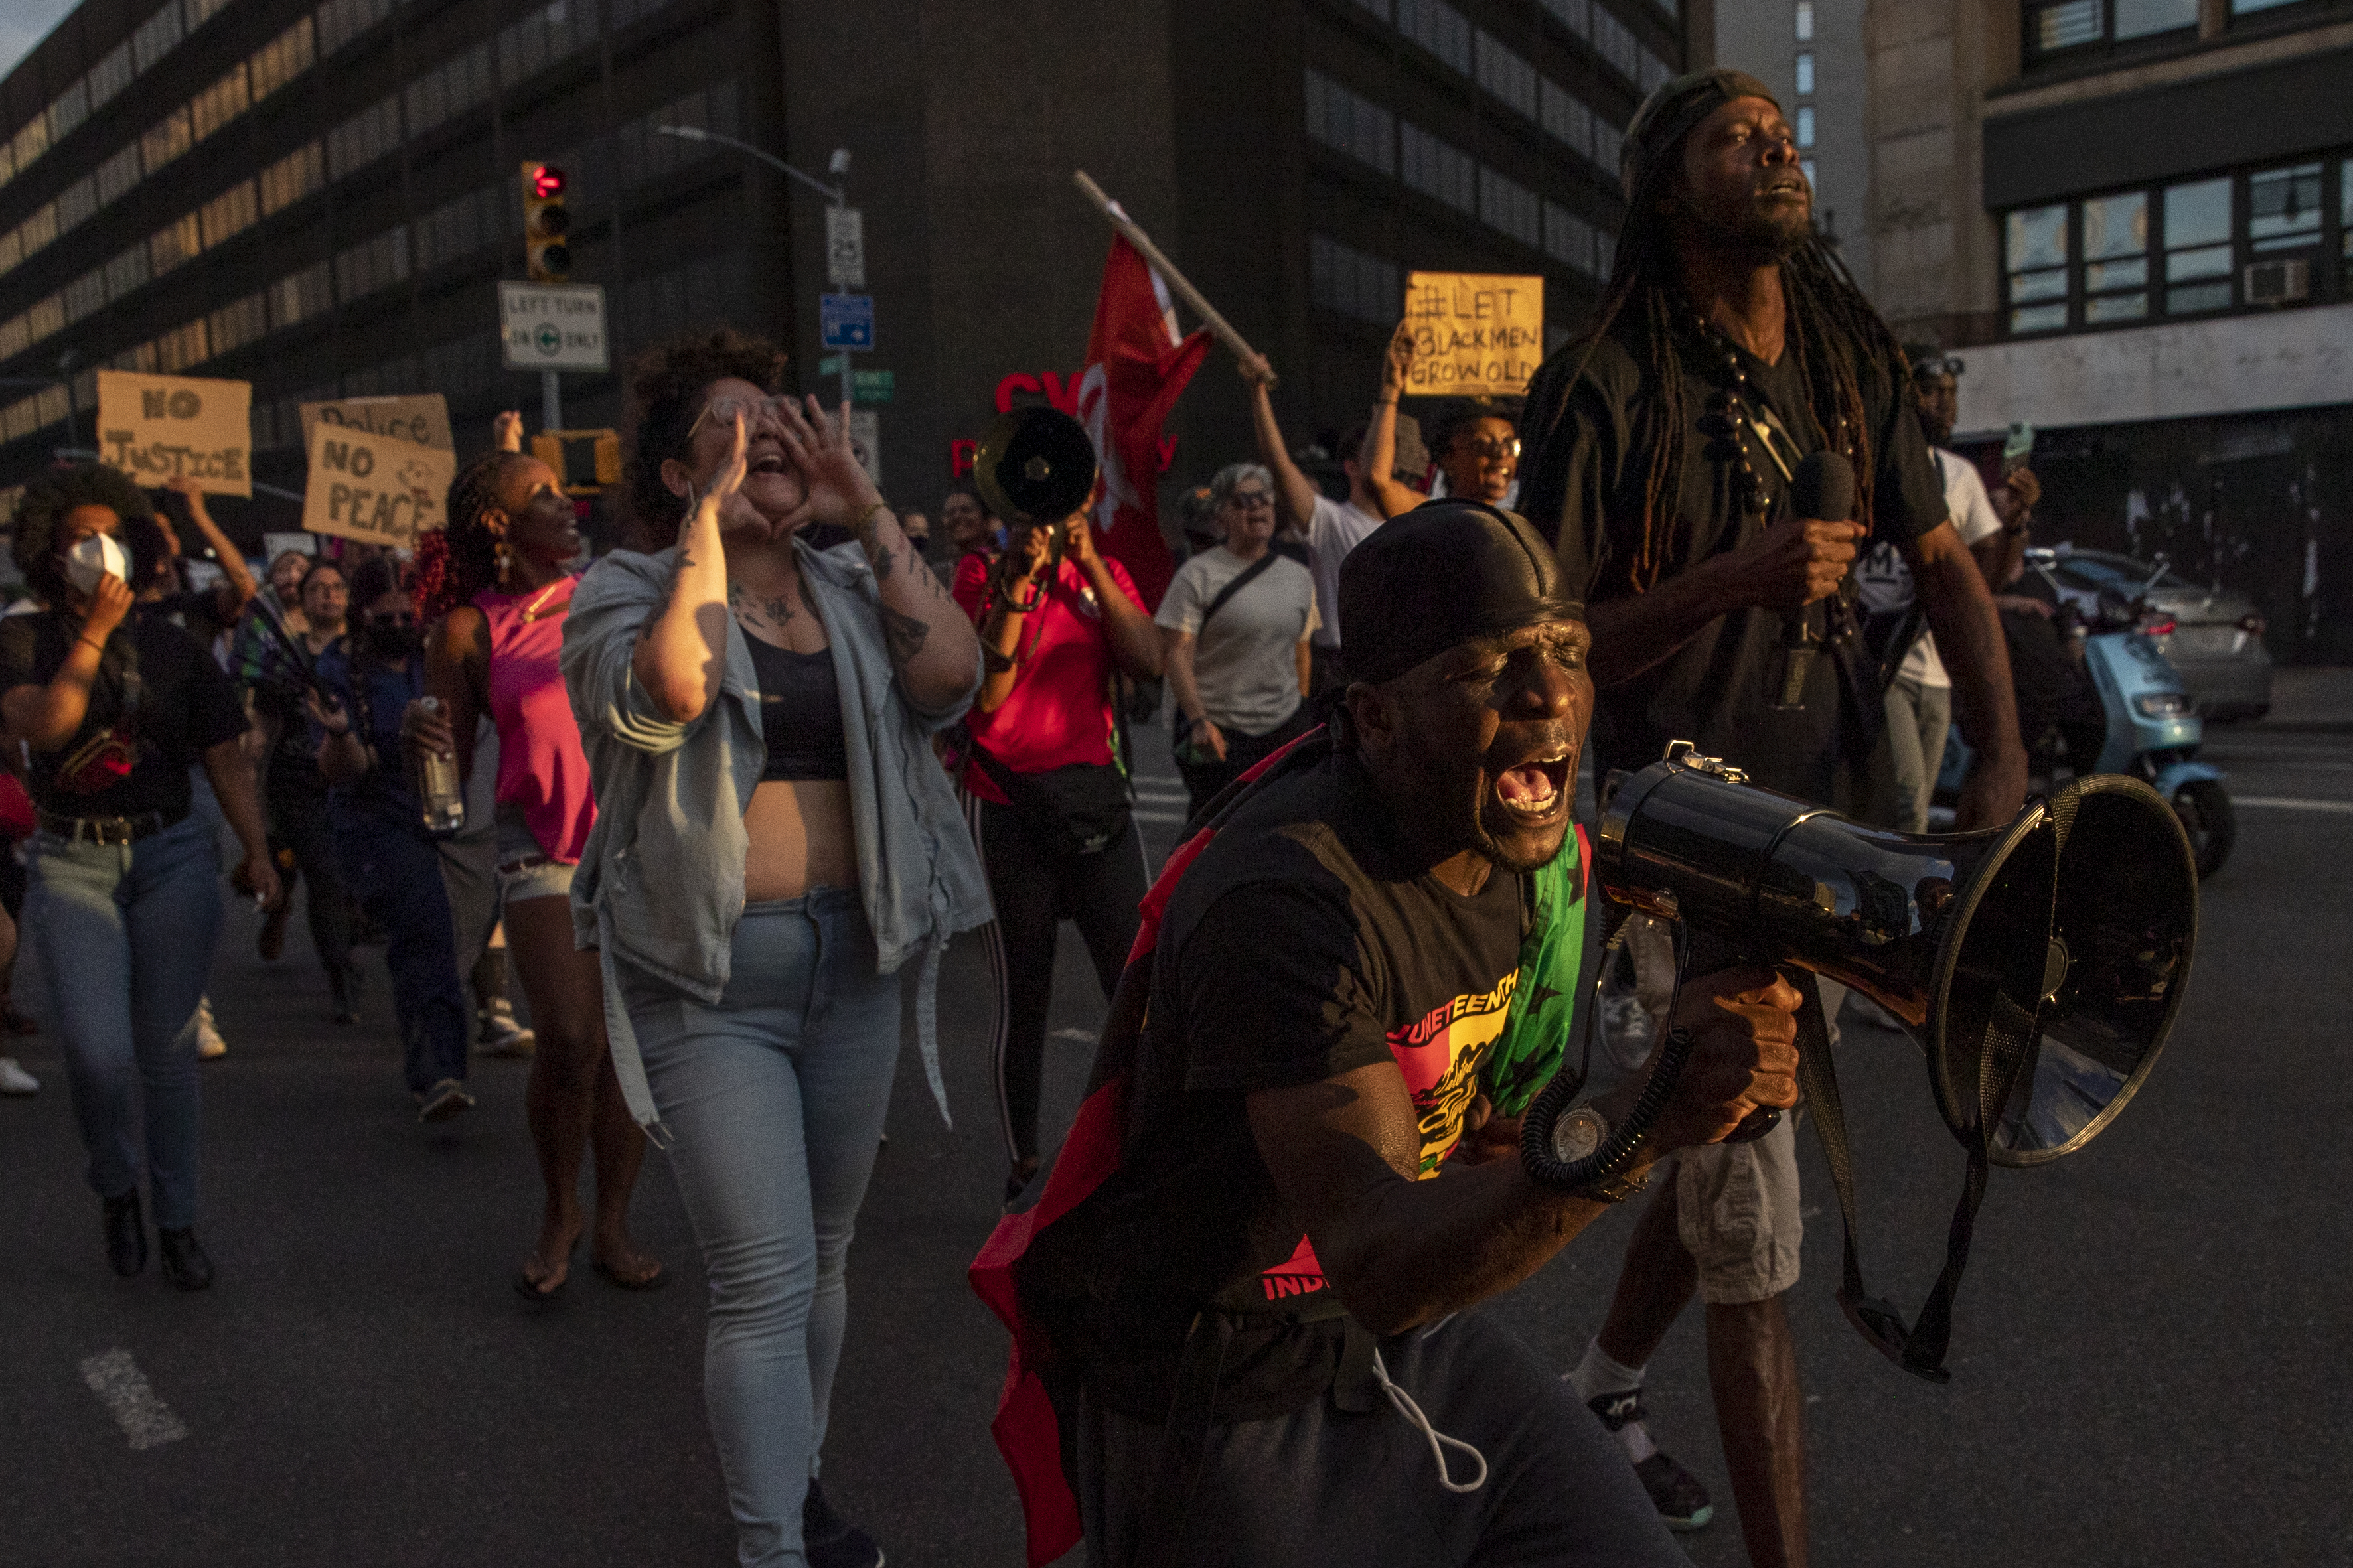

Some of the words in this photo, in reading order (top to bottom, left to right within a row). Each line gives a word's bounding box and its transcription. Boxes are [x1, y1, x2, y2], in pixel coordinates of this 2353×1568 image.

[509, 295, 548, 314] LEFT
[1406, 285, 1516, 319] #LET
[1410, 360, 1481, 386] GROW
[141, 389, 202, 421] NO
[323, 440, 375, 479] NO
[329, 484, 435, 547] PEACE
[1386, 967, 1519, 1044] JUNETEENTH
